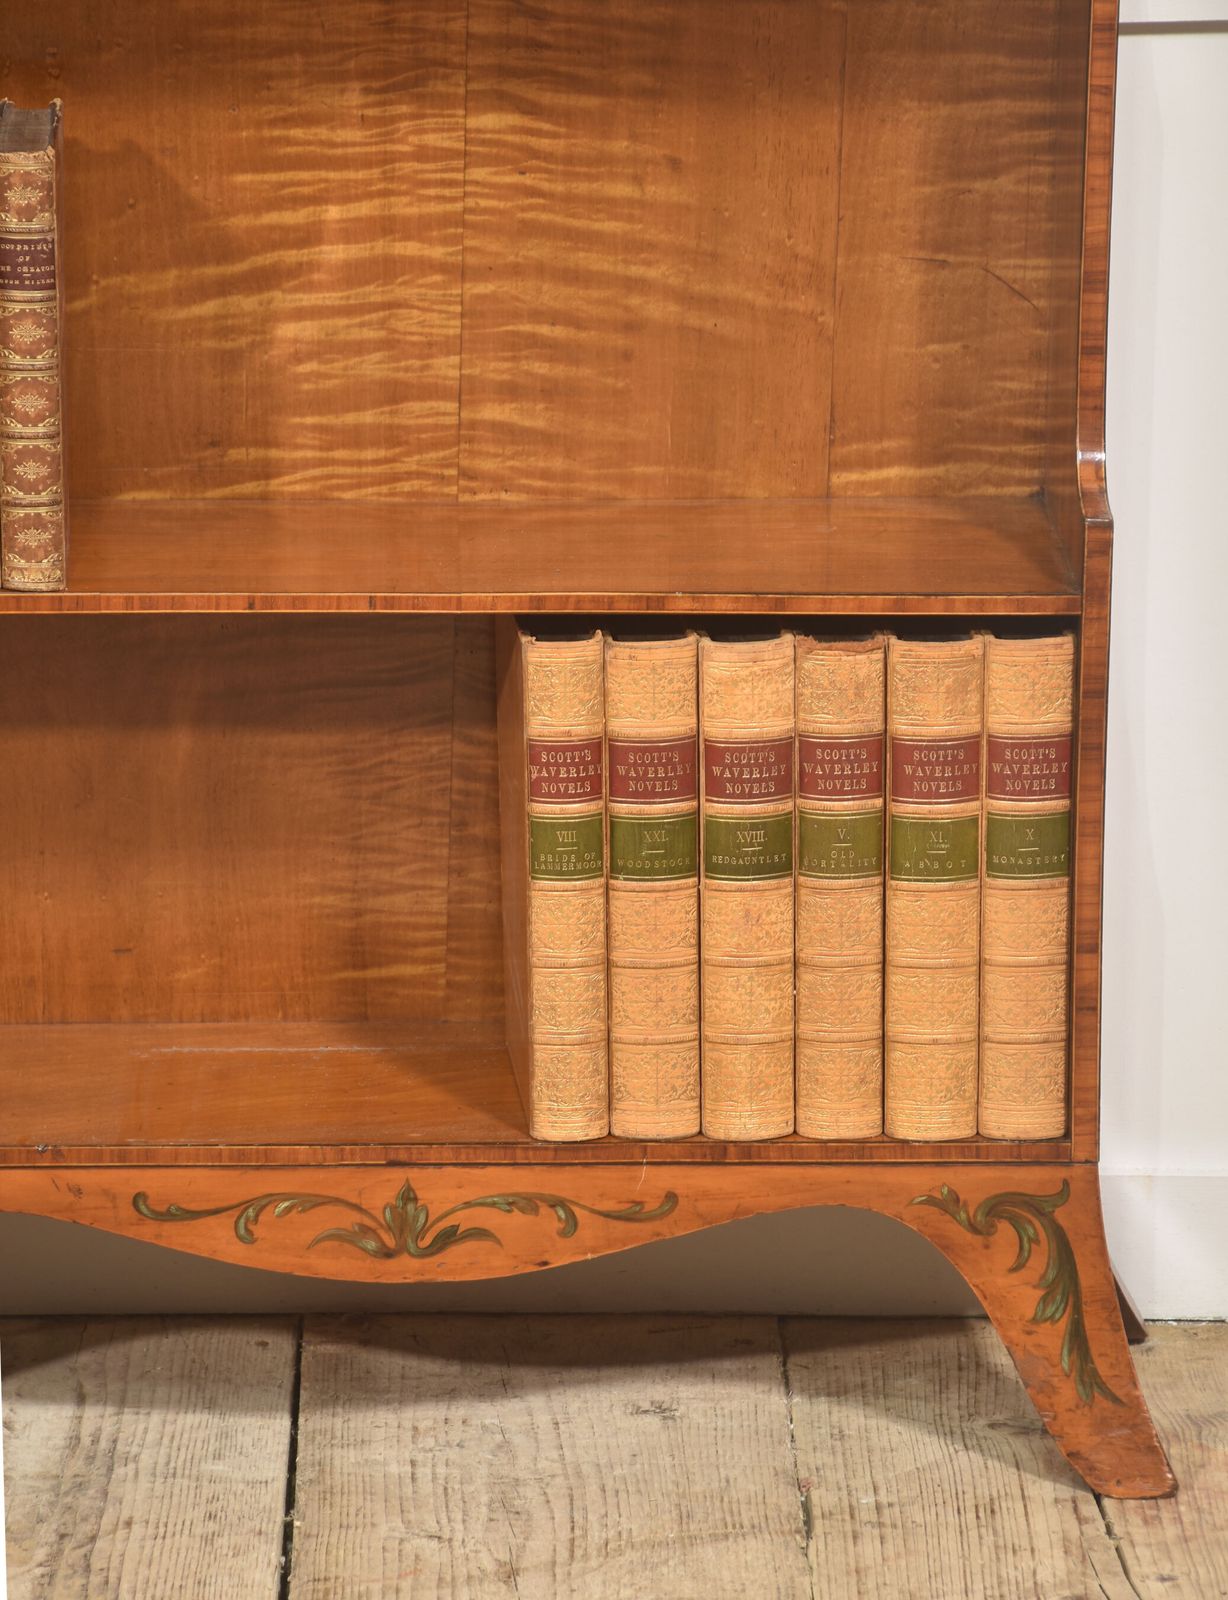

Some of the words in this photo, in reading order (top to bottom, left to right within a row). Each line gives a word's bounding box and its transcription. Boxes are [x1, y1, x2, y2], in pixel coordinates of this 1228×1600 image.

[541, 750, 592, 763] SCOTT'S
[628, 752, 679, 763] SCOTT'S
[725, 752, 775, 763] SCOTT'S
[816, 749, 867, 760] SCOTT'S
[914, 749, 964, 761] SCOTT'S
[1005, 748, 1056, 760] SCOTT'S
[530, 765, 601, 777] WAVERLEY
[617, 763, 691, 777] WAVERLEY
[712, 764, 786, 778] WAVERLEY
[803, 762, 878, 775] WAVERLEY
[904, 763, 978, 777] WAVERLEY
[992, 762, 1068, 774] WAVERLEY
[542, 782, 591, 793] NOVELS
[628, 780, 678, 791] NOVELS
[726, 782, 775, 794] NOVELS
[817, 779, 867, 790] NOVELS
[913, 781, 962, 792] NOVELS
[1006, 779, 1056, 790] NOVELS
[556, 831, 576, 842] VIII
[540, 853, 575, 862] BRIDE
[585, 852, 596, 860] OF
[712, 854, 786, 865] REDGAUNTLET
[831, 851, 854, 859] OLD
[993, 854, 1065, 865] MONASTERY
[618, 858, 690, 868] WOODSTOCK
[905, 860, 966, 869] ABBOT
